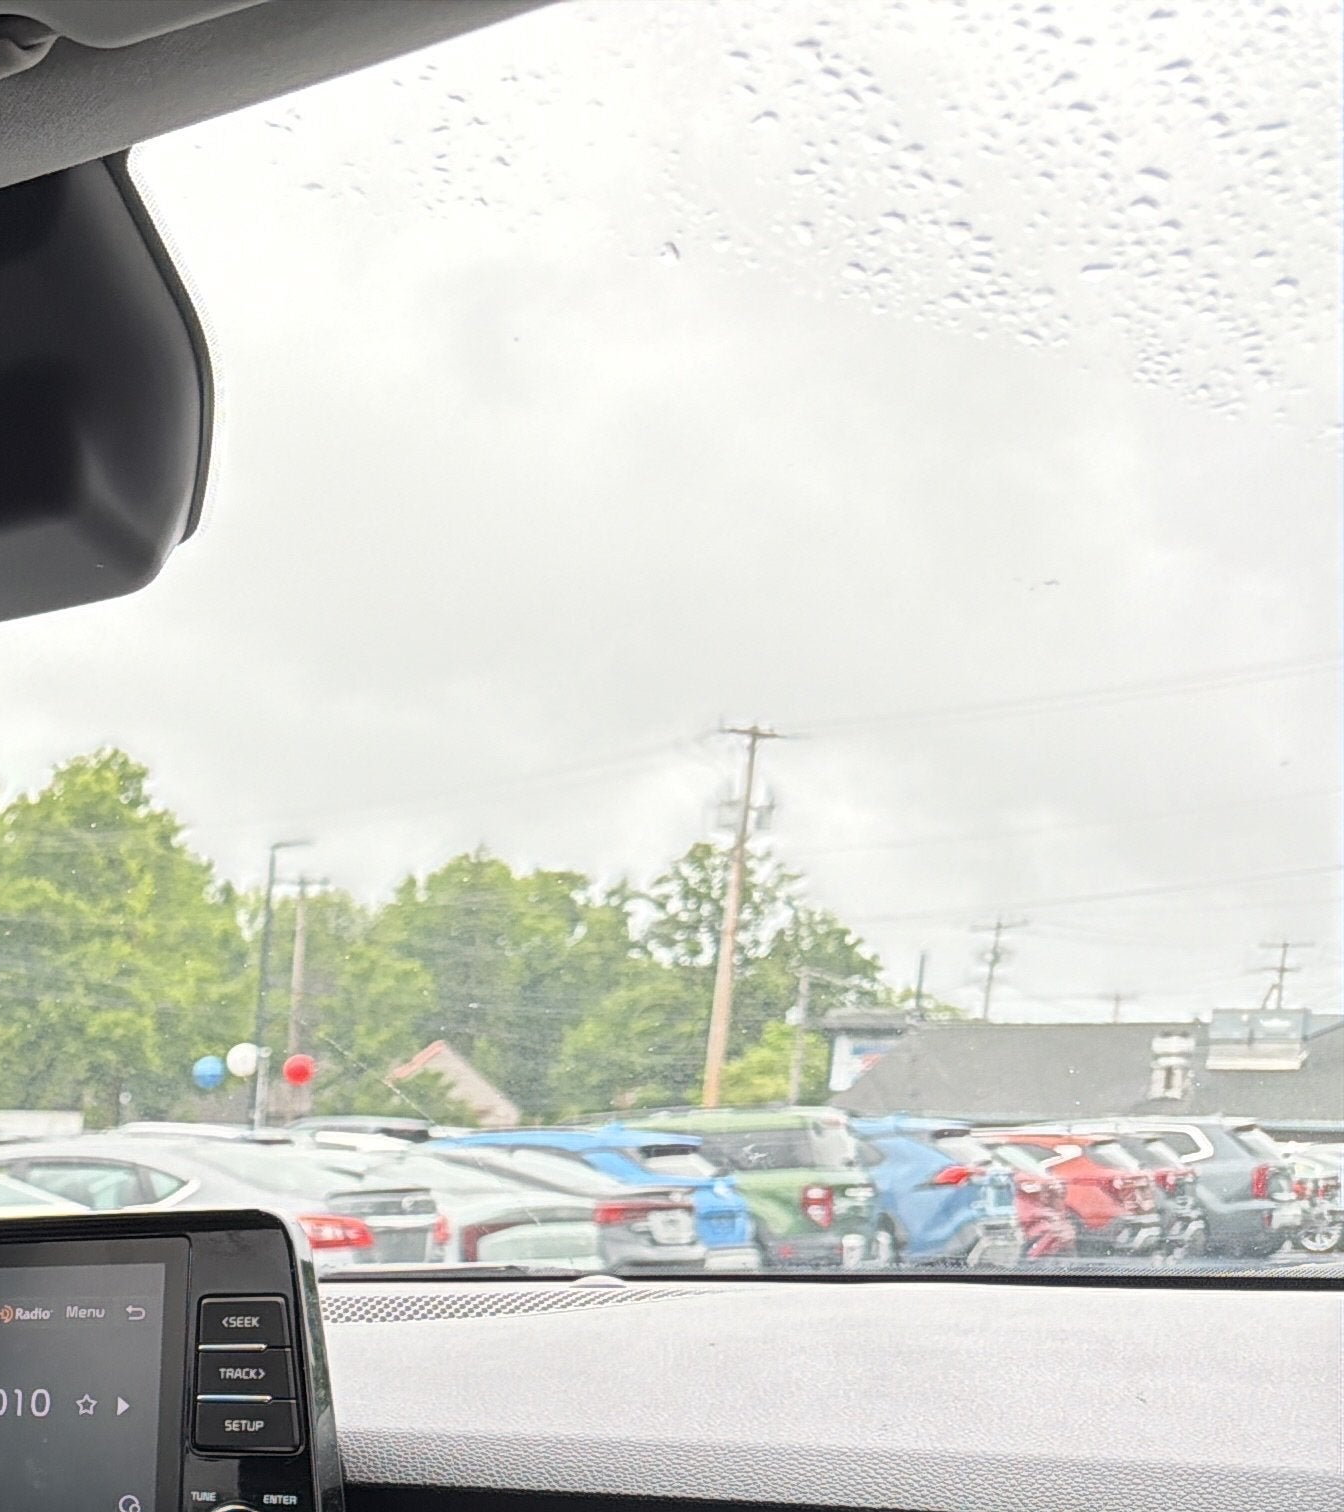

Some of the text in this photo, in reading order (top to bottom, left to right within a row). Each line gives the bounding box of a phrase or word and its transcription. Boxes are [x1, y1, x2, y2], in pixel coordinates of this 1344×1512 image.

[15, 1307, 51, 1320] Radio
[65, 1305, 105, 1320] Menu
[224, 1420, 265, 1432] SETUP
[191, 1491, 217, 1502] TUNE
[263, 1494, 298, 1506] ENTER
